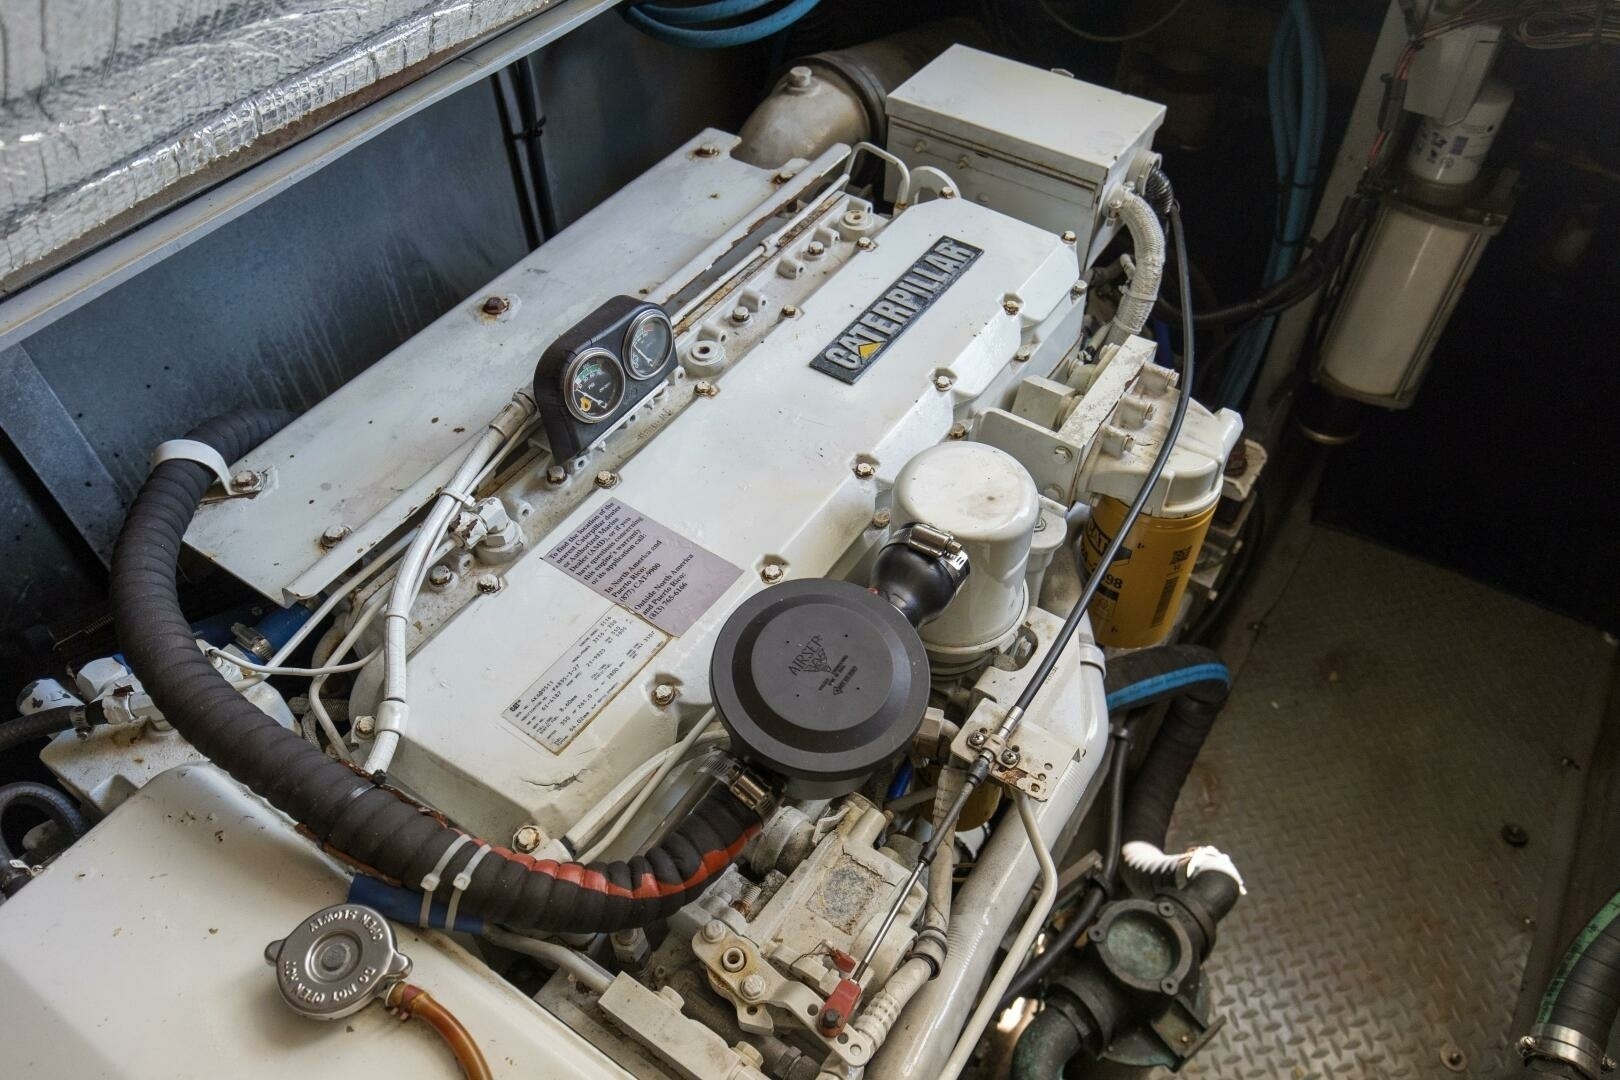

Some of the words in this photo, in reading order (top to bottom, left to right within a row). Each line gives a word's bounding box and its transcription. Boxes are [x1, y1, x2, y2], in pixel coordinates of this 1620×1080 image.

[825, 241, 975, 369] CATERPILLAR
[556, 542, 569, 553] find
[568, 534, 578, 543] the
[577, 516, 600, 534] location
[556, 546, 577, 564] nearest
[575, 520, 605, 546] Caterpillar
[605, 506, 621, 521] dealer
[569, 555, 589, 572] Dealer
[587, 538, 610, 556] (AMD),
[620, 517, 631, 527] you
[570, 534, 600, 562] Authorized
[598, 518, 619, 536] Marine
[576, 564, 591, 576] have
[590, 542, 616, 564] questions
[615, 517, 644, 542] concerning
[584, 571, 595, 581] this
[595, 551, 617, 571] engine's
[616, 529, 641, 550] warranty
[605, 545, 636, 572] application
[611, 572, 630, 587] North
[628, 551, 652, 573] America
[651, 540, 662, 551] and
[611, 581, 632, 598] Puerto
[630, 566, 646, 580] Rico:
[619, 588, 635, 602] (877)
[634, 591, 656, 610] Outside
[654, 575, 673, 591] North
[671, 554, 694, 576] America
[643, 604, 654, 616] and
[651, 587, 672, 605] Puerto
[670, 573, 686, 587] Rico:
[649, 606, 665, 620] (813)
[662, 582, 688, 606] 765-6166
[788, 635, 823, 676] AIRSEP
[308, 909, 358, 932] SLOWLY
[359, 913, 383, 942] OPEN
[291, 983, 325, 1003] OPEN
[331, 983, 357, 1002] NOT
[358, 967, 376, 984] DO
